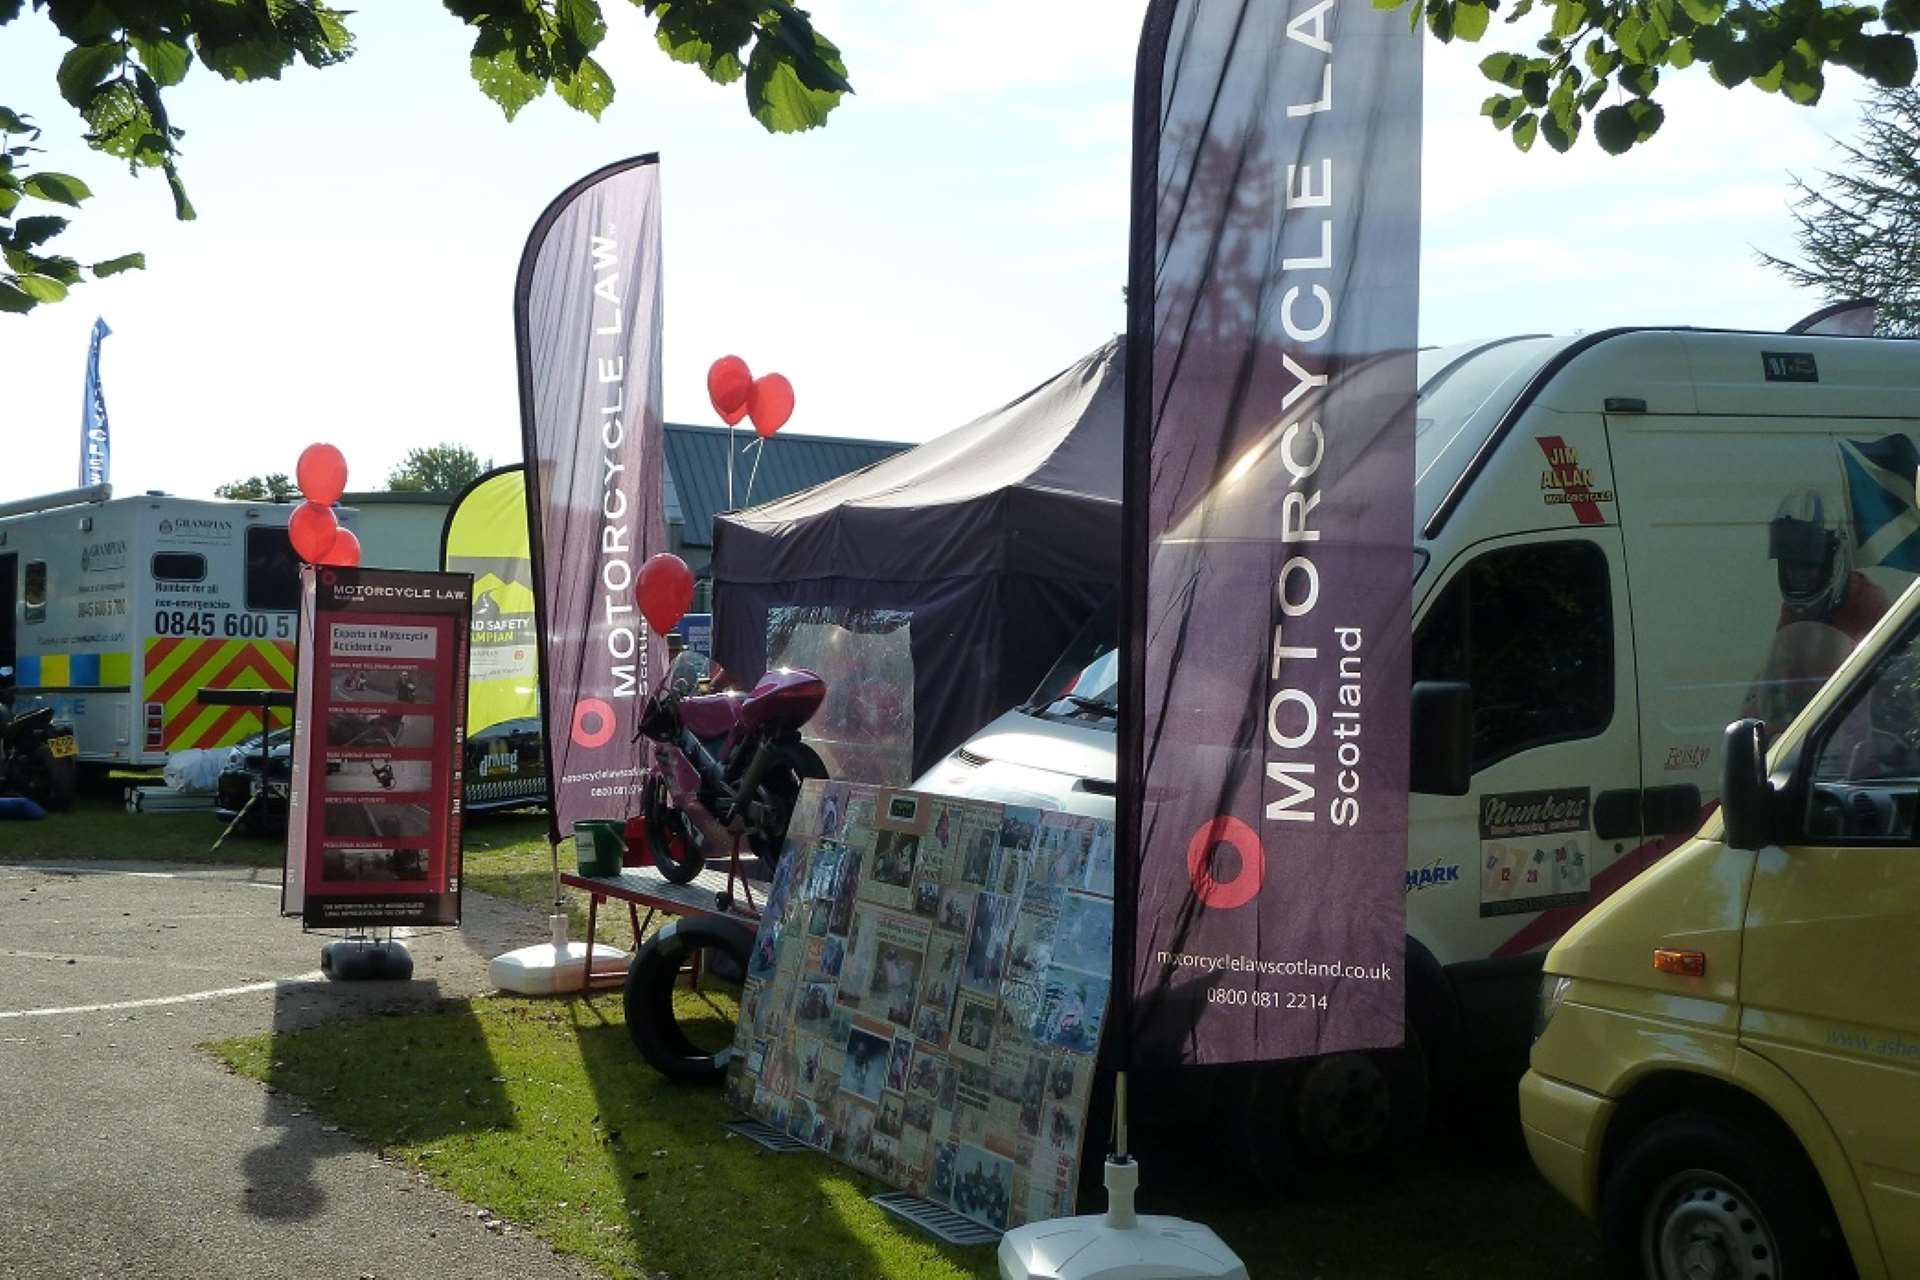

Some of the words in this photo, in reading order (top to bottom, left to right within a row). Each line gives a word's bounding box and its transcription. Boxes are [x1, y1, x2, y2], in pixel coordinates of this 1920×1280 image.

[591, 235, 624, 335] LAW
[1550, 446, 1578, 466] JIM
[1266, 159, 1332, 822] MOTORCYCLE
[1541, 469, 1595, 488] ALLAN
[599, 355, 637, 697] MOTORCYCLE
[334, 585, 431, 598] MOTORCYCLE
[155, 611, 215, 637] 0845
[224, 613, 268, 638] 600
[276, 615, 289, 638] 5
[487, 618, 530, 631] SAFETY
[1330, 627, 1363, 827] Scotland
[1484, 795, 1585, 826] Numbers
[1207, 987, 1247, 1006] 0800
[1251, 990, 1280, 1008] 081
[1286, 992, 1328, 1010] 2214
